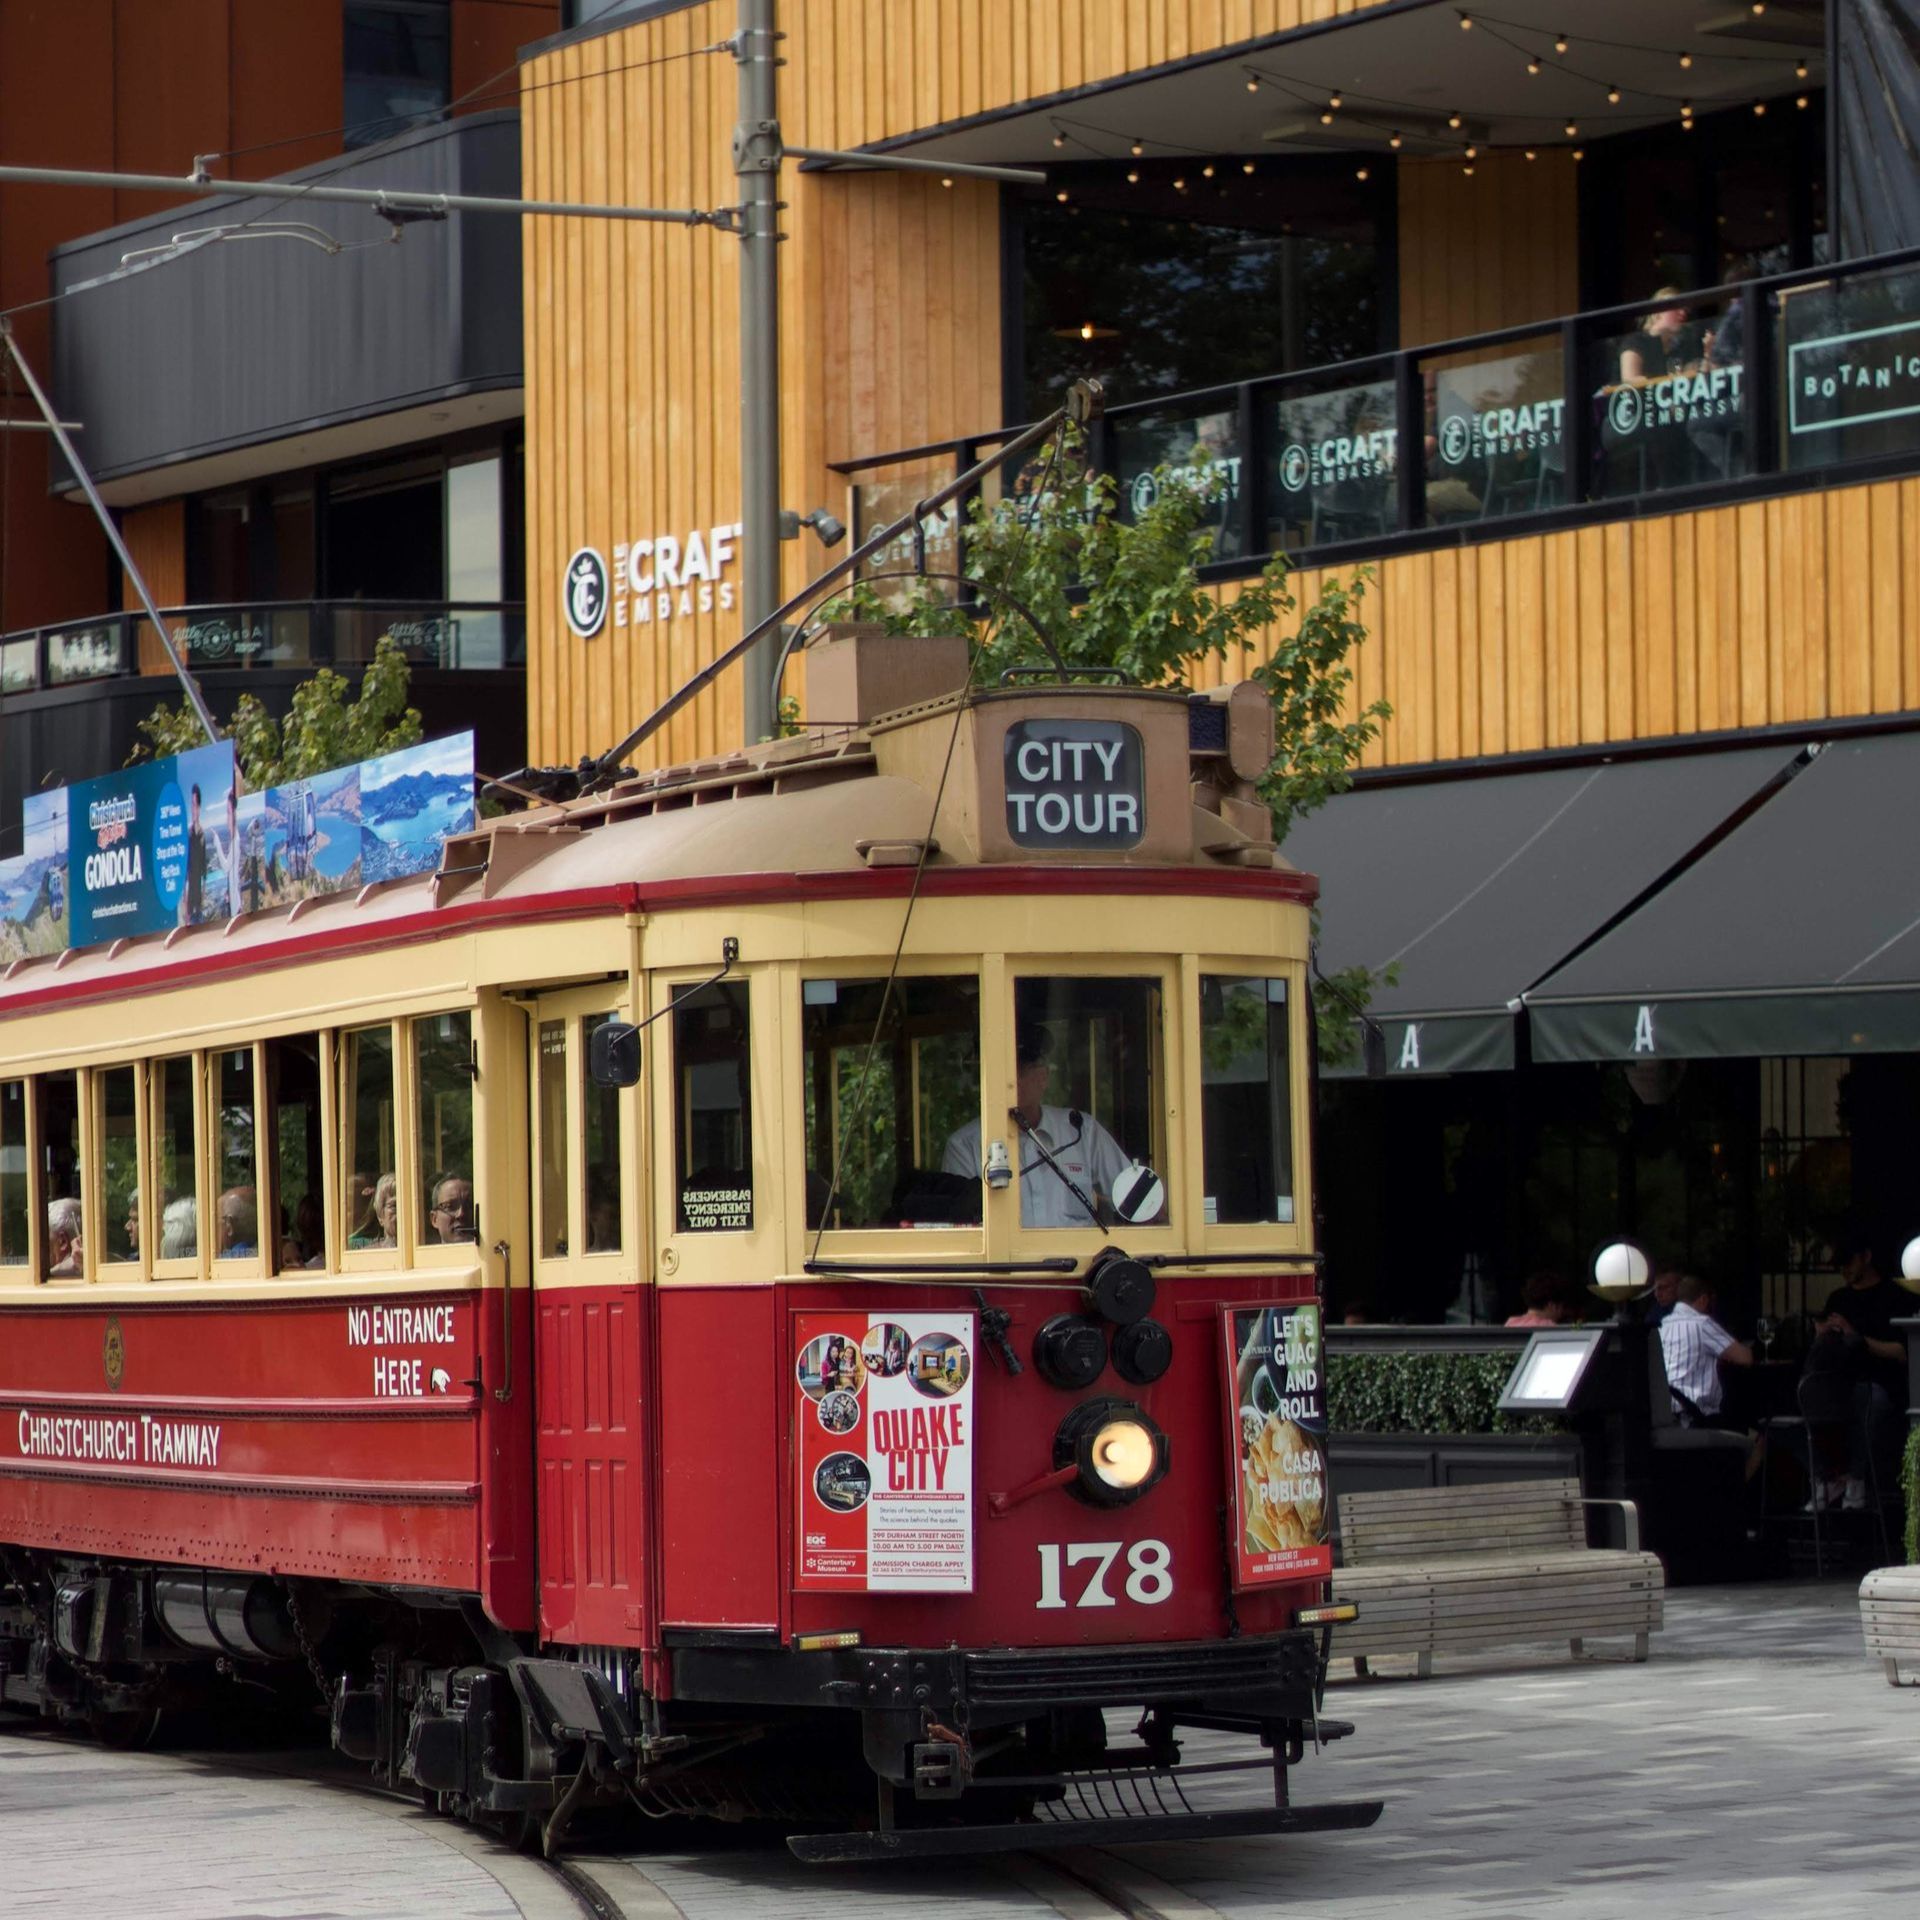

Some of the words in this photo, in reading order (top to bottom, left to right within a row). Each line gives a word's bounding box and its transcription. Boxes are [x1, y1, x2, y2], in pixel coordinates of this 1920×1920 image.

[1655, 364, 1743, 408] CRAFT
[1804, 354, 1920, 398] BOTANIC
[1482, 398, 1565, 440] CRAFT
[1644, 395, 1742, 428] EMBASSY
[1321, 428, 1398, 468] CRAFT
[1472, 429, 1562, 459] EMBASSY
[1311, 458, 1394, 486] EMBASSY
[629, 522, 742, 594] CRAF
[614, 580, 743, 628] EMBASS
[1017, 741, 1123, 782] CITY
[1007, 793, 1138, 834] TOUR
[85, 845, 142, 891] GONDOLA
[348, 1306, 369, 1345] NO
[373, 1305, 454, 1345] ENTRANCE
[1274, 1315, 1314, 1339] LET'S
[1274, 1342, 1316, 1366] GUAC
[374, 1356, 423, 1396] HERE
[1286, 1369, 1317, 1393] AND
[1280, 1396, 1319, 1420] ROLL
[19, 1408, 136, 1461] CHRISTCHURCH
[140, 1415, 220, 1466] TRAMWAY
[873, 1403, 964, 1456] QUAKE
[889, 1448, 949, 1491] CITY
[1283, 1450, 1321, 1473] CASA
[1260, 1477, 1322, 1504] PUBLICA
[806, 1536, 826, 1545] EQC
[817, 1559, 856, 1567] Canterbury
[1036, 1539, 1173, 1608] 178
